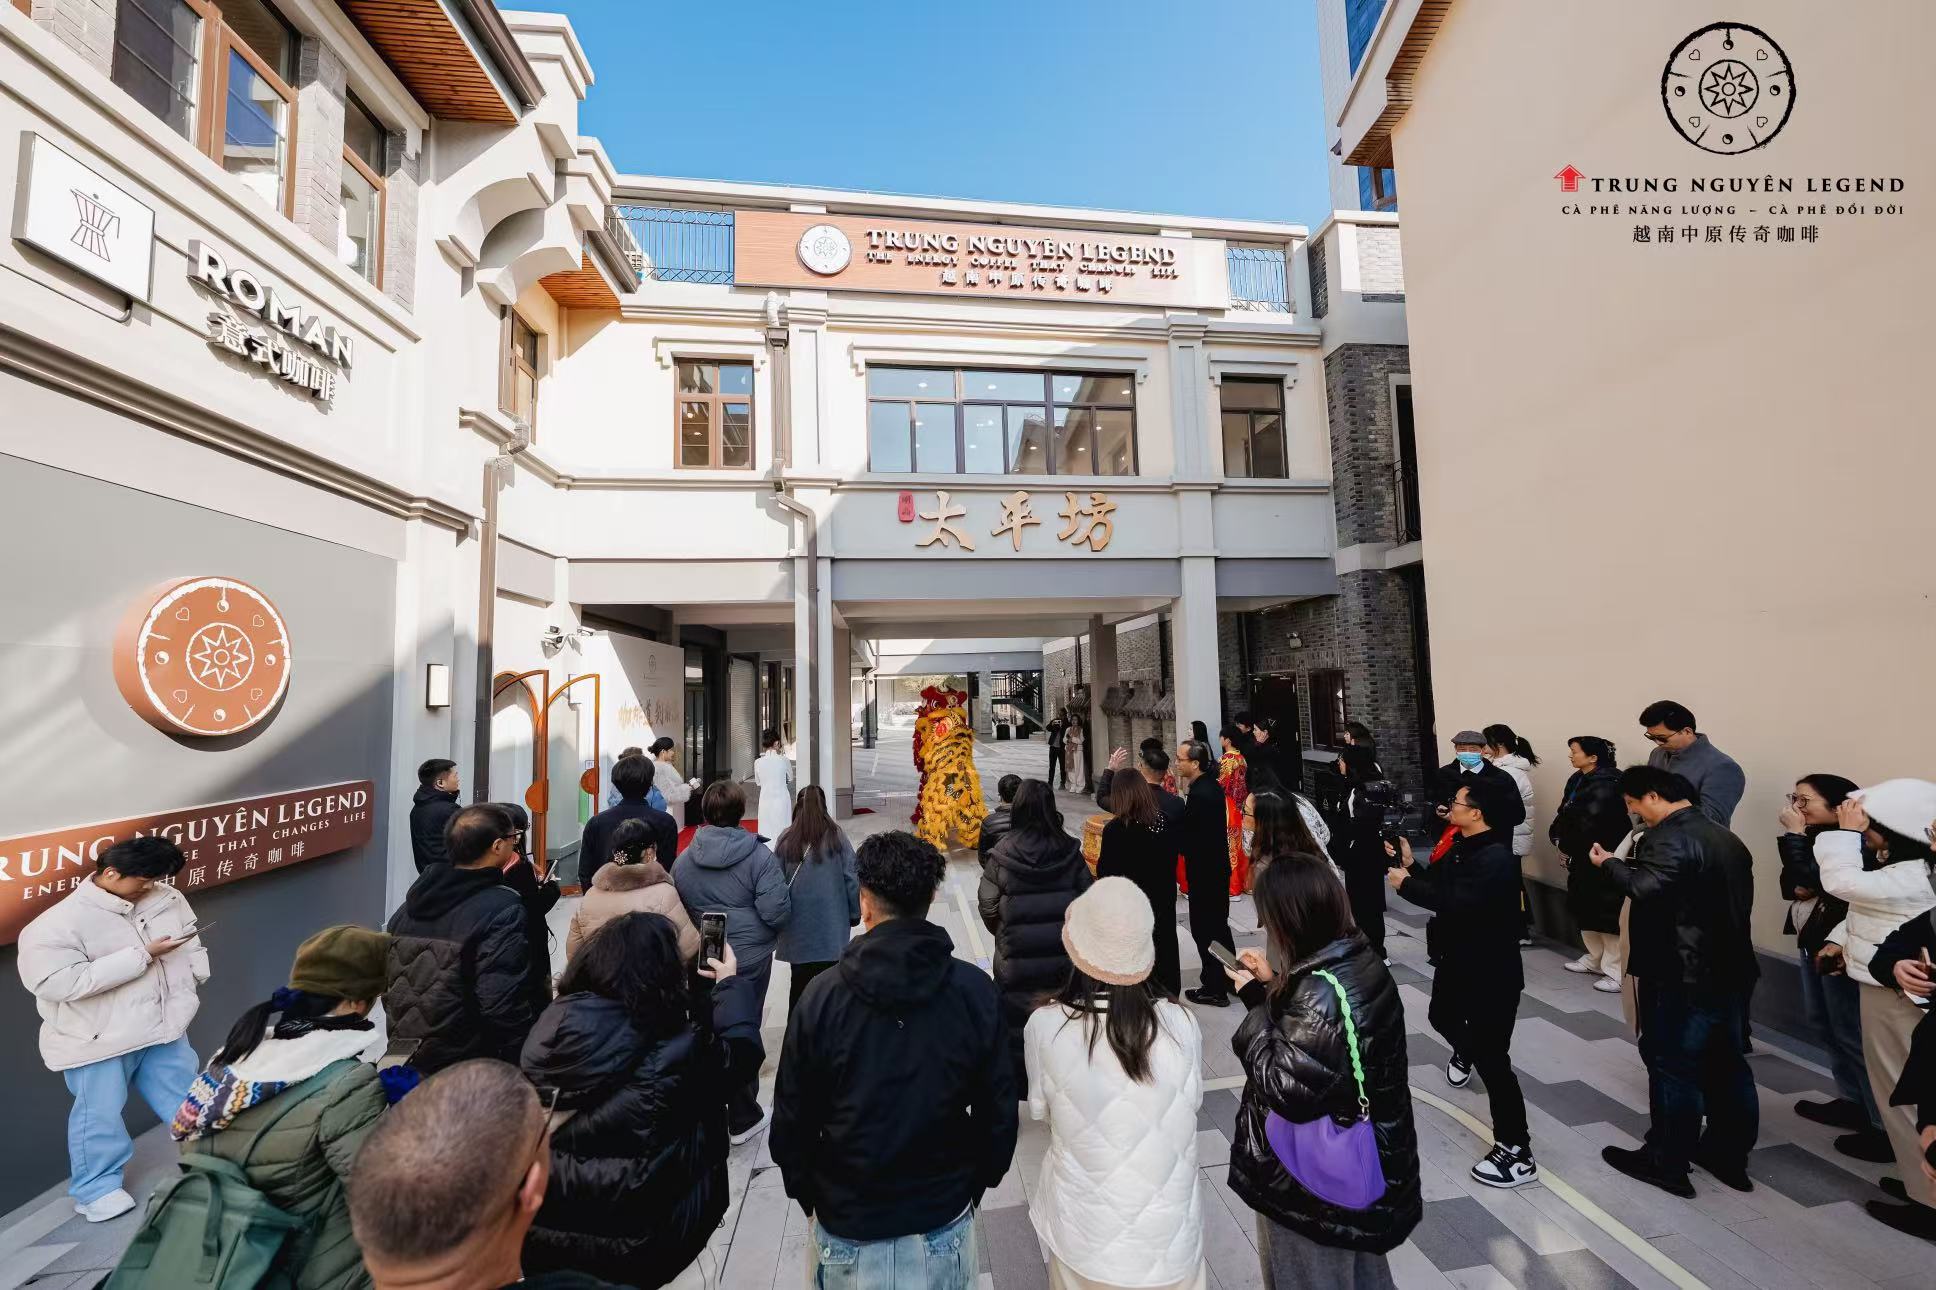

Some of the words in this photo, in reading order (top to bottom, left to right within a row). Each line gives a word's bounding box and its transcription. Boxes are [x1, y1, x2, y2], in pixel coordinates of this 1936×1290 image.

[866, 229, 960, 253] TRUNG
[967, 235, 1075, 261] NGUYÊN
[1081, 242, 1177, 266] LEGEND
[866, 251, 893, 263] THE
[187, 239, 354, 370] ROMAN
[207, 311, 336, 401] 意式咖啡
[914, 490, 1118, 552] 太平坊
[276, 789, 367, 824] LEGEND
[218, 835, 258, 854] THAT
[272, 819, 330, 840] CHANGES
[343, 811, 367, 824] LIFE
